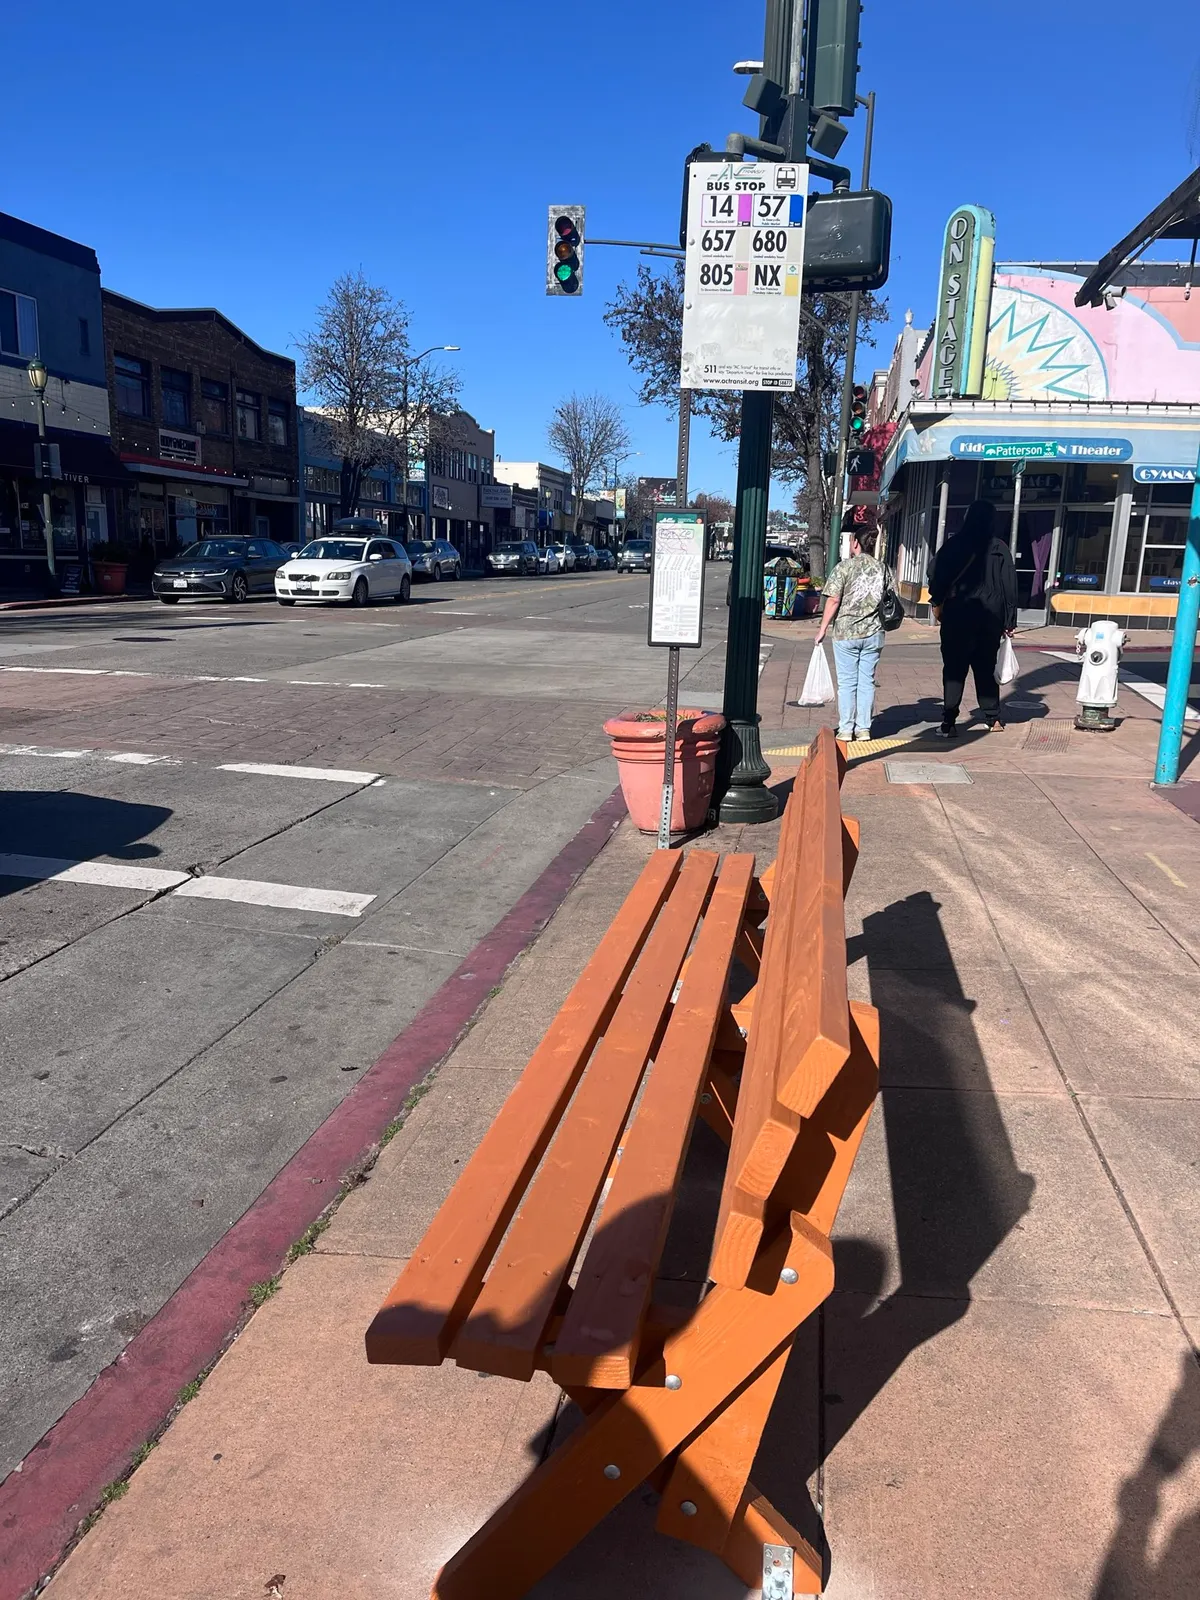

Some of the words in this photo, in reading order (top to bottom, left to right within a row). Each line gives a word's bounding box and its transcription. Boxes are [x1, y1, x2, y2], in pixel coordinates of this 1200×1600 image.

[706, 182, 730, 191] BUS
[734, 182, 766, 192] STOP
[710, 195, 734, 217] 14
[758, 196, 786, 218] 57
[702, 230, 736, 252] 657
[752, 230, 787, 252] 680
[949, 217, 968, 265] ON
[700, 264, 733, 285] 805
[754, 264, 782, 286] NX
[938, 273, 961, 390] STAGE
[704, 364, 717, 373] 511
[703, 378, 759, 386] www.actransit.org
[996, 446, 1042, 456] Patterson
[1070, 445, 1124, 456] Theater
[1140, 469, 1196, 480] GYMNA
